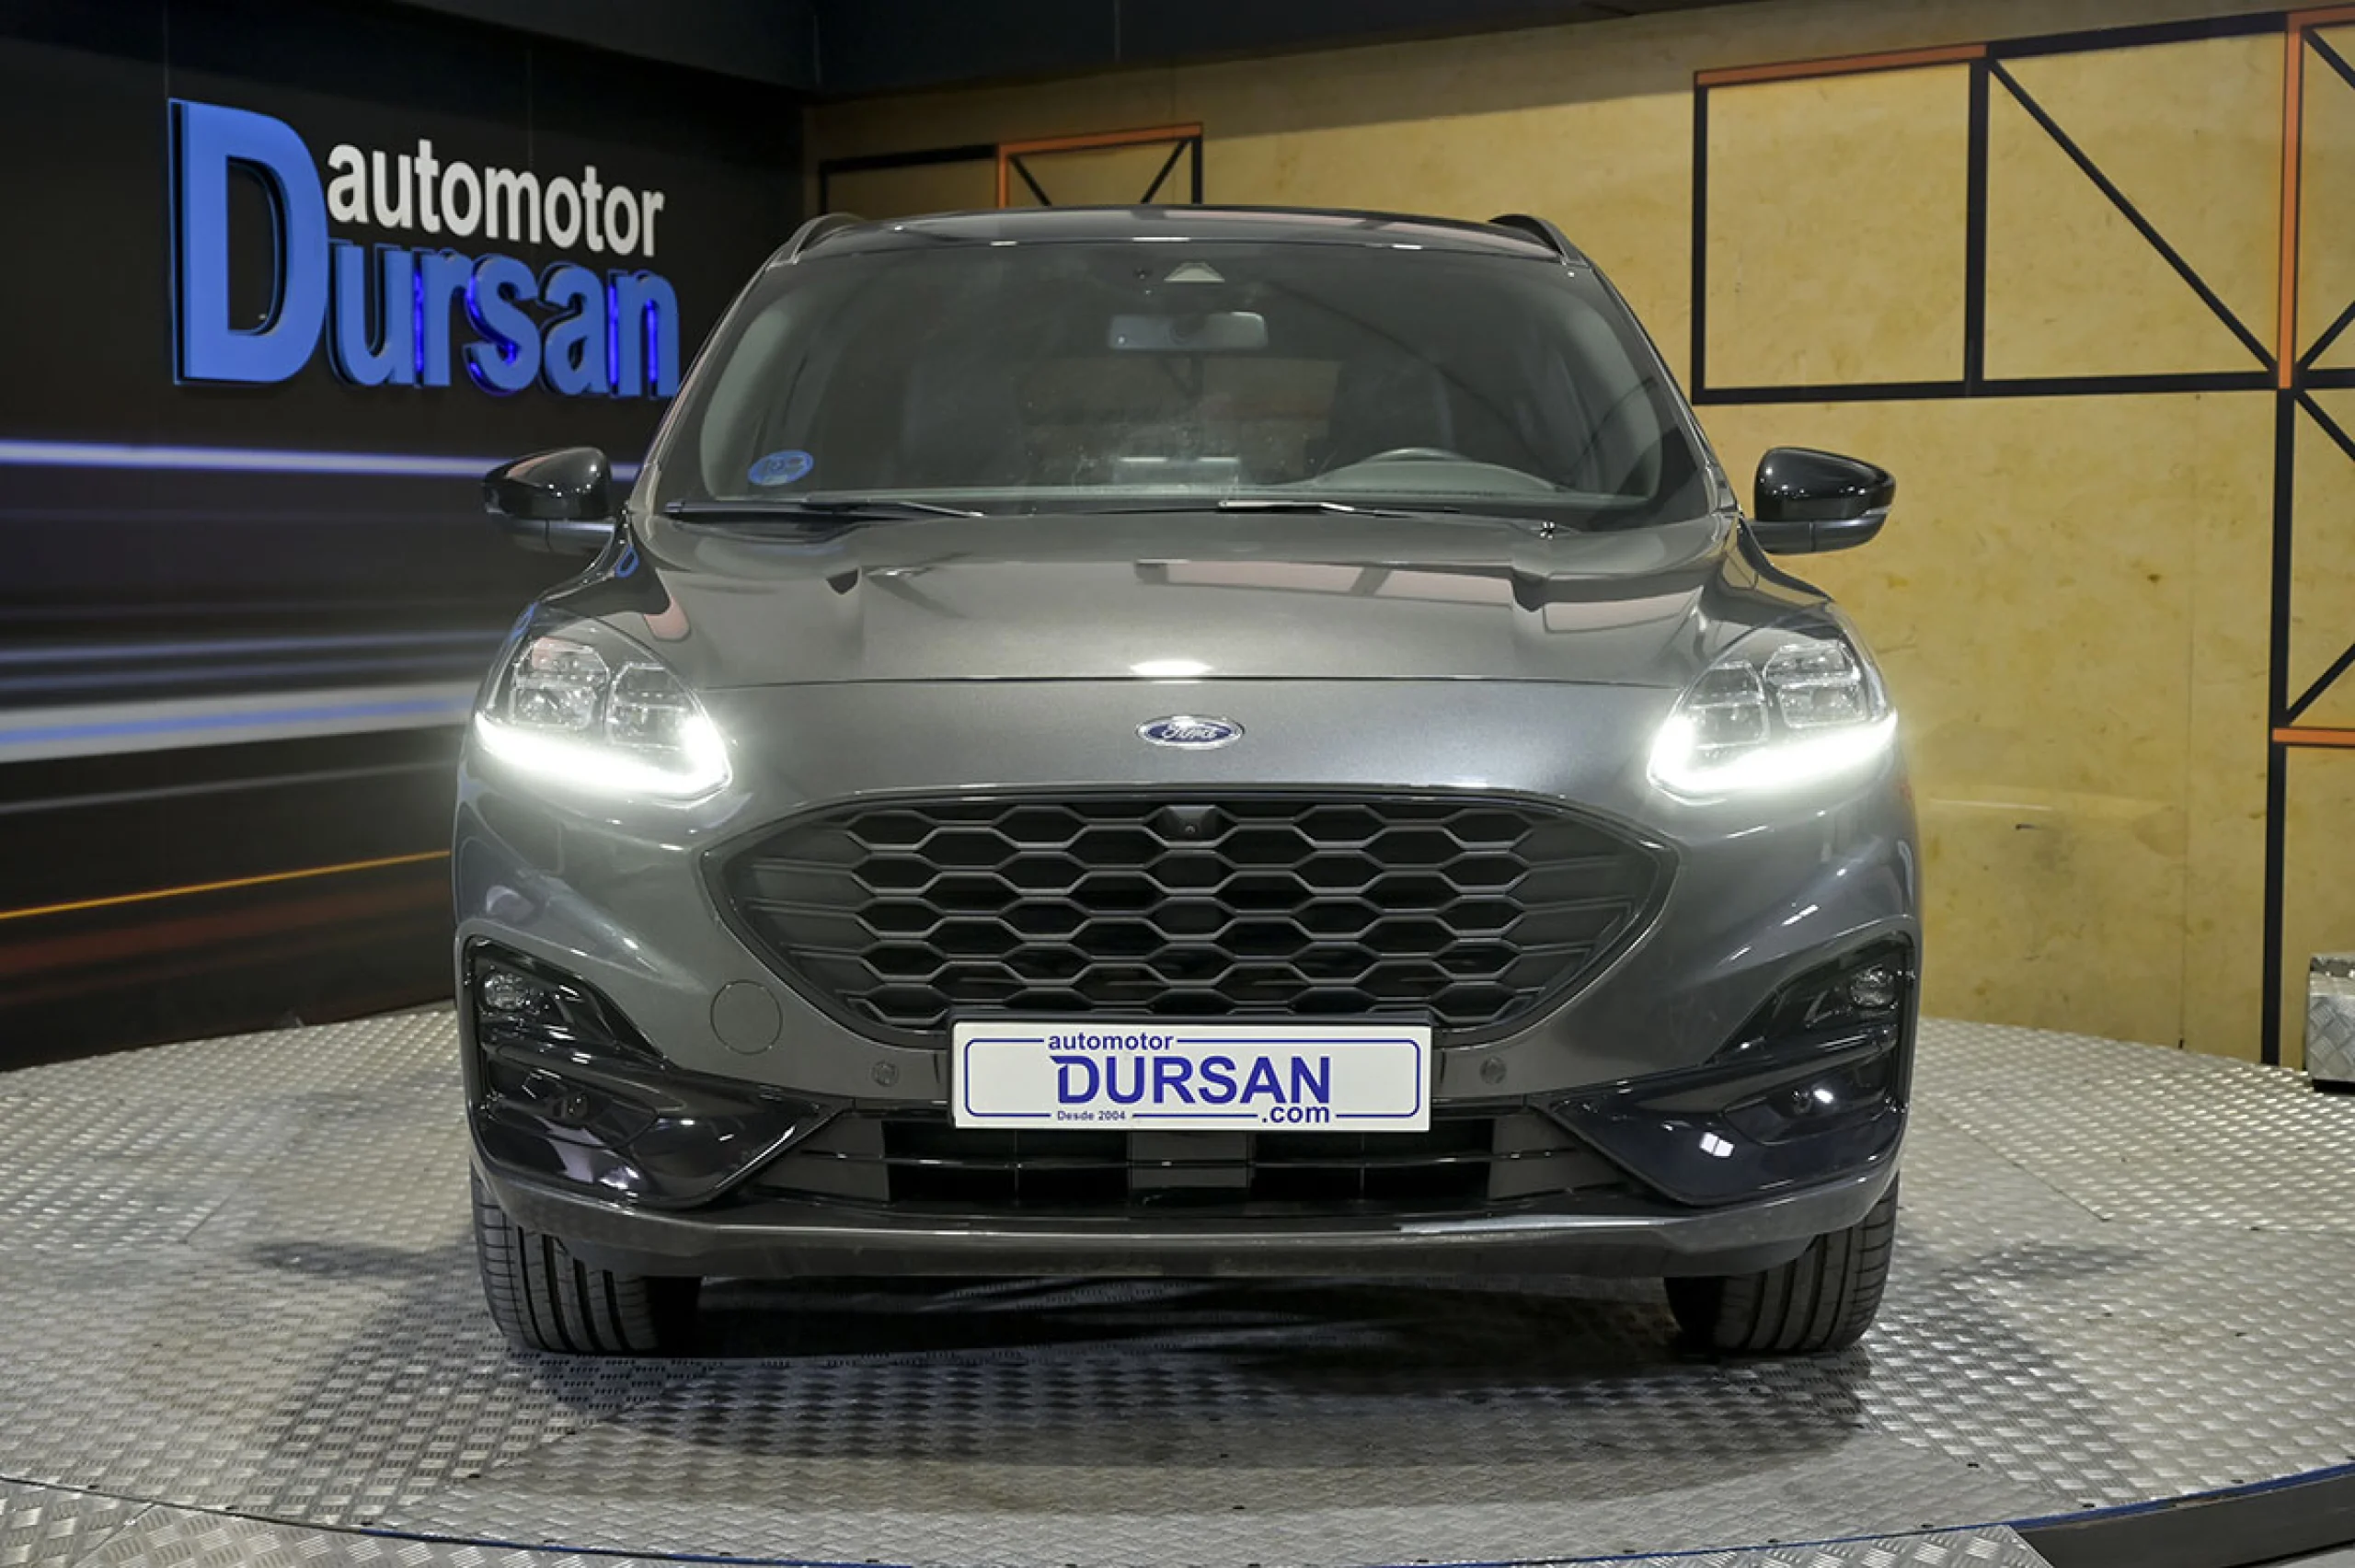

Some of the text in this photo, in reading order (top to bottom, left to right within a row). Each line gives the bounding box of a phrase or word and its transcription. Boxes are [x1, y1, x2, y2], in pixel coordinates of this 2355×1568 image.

[327, 139, 664, 257] automotor
[168, 97, 680, 398] Dursan
[1048, 1032, 1174, 1050] automotor
[1050, 1056, 1330, 1104] DURSAN
[1057, 1110, 1125, 1121] Desde 2004
[1261, 1106, 1329, 1124] .com
